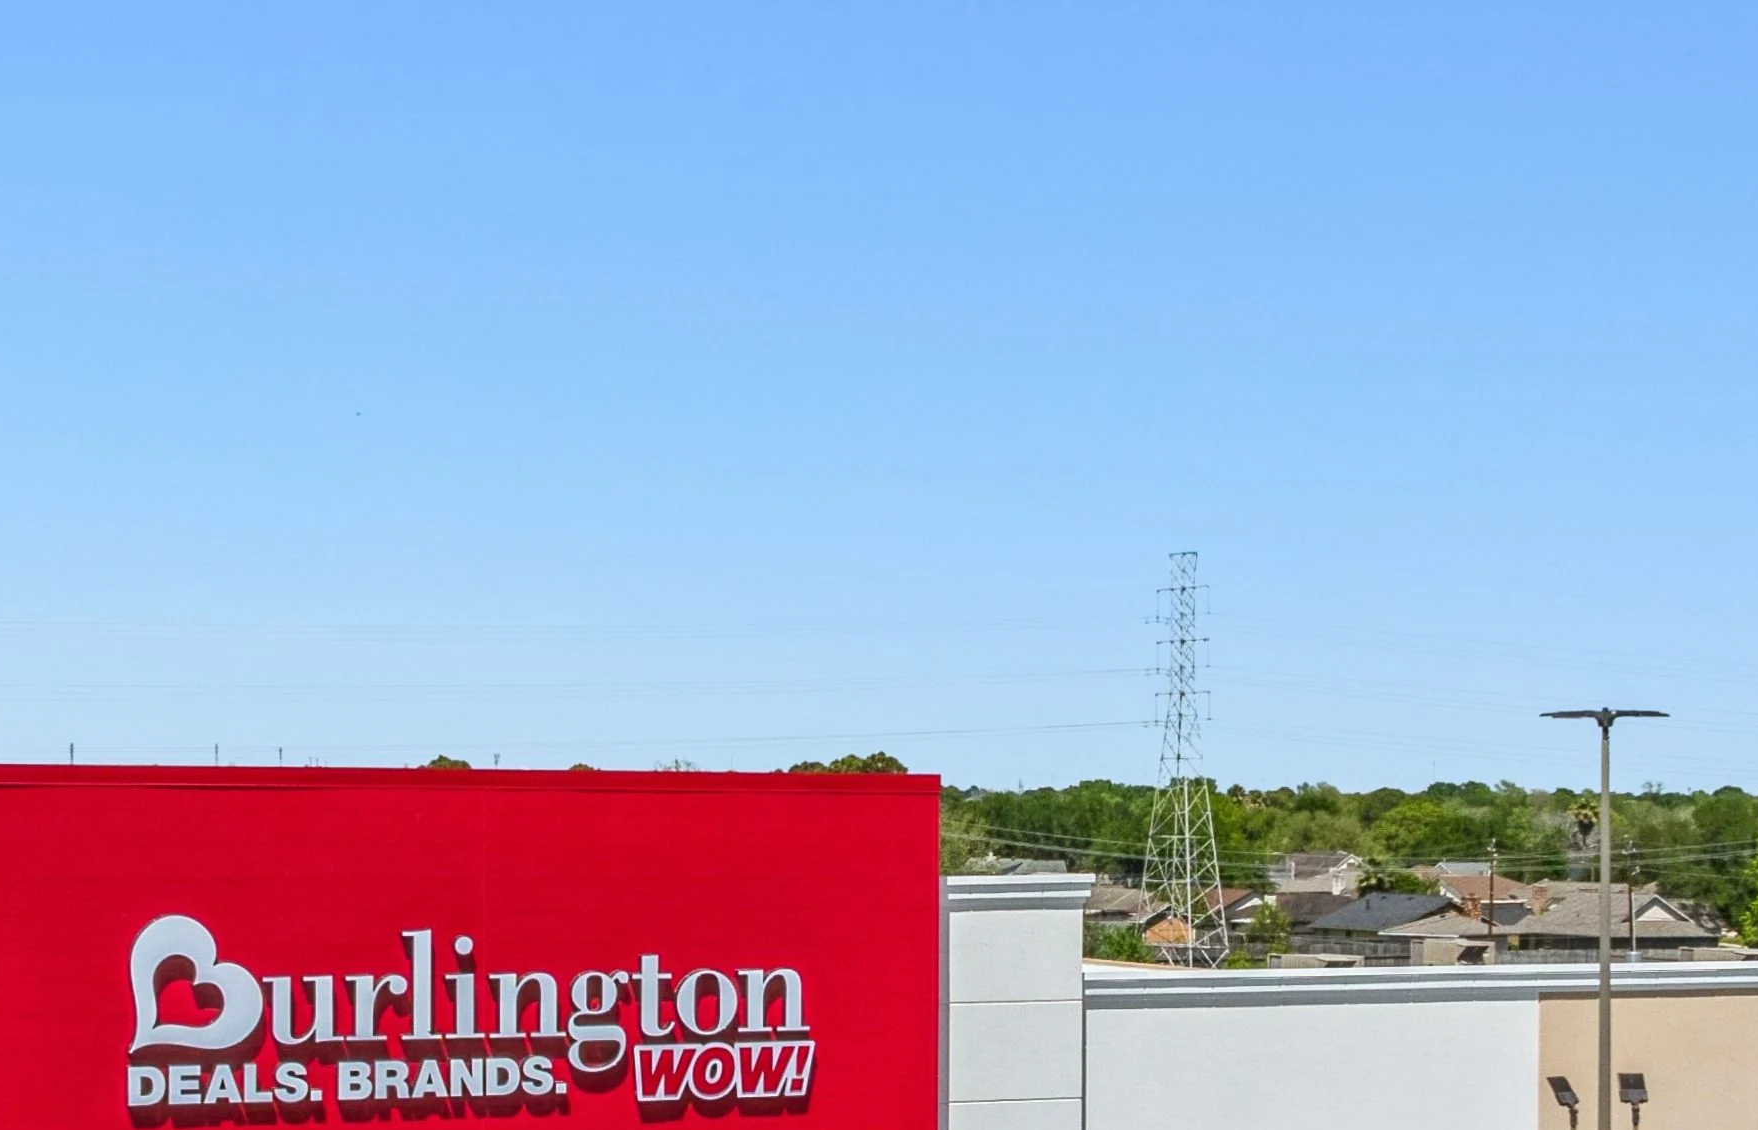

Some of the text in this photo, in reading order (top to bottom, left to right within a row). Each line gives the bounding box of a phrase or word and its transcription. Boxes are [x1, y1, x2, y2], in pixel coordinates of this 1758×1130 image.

[129, 915, 810, 1072] Burlington
[128, 1056, 567, 1107] DEALS. BRANDS.
[633, 1041, 815, 1103] WOW!
